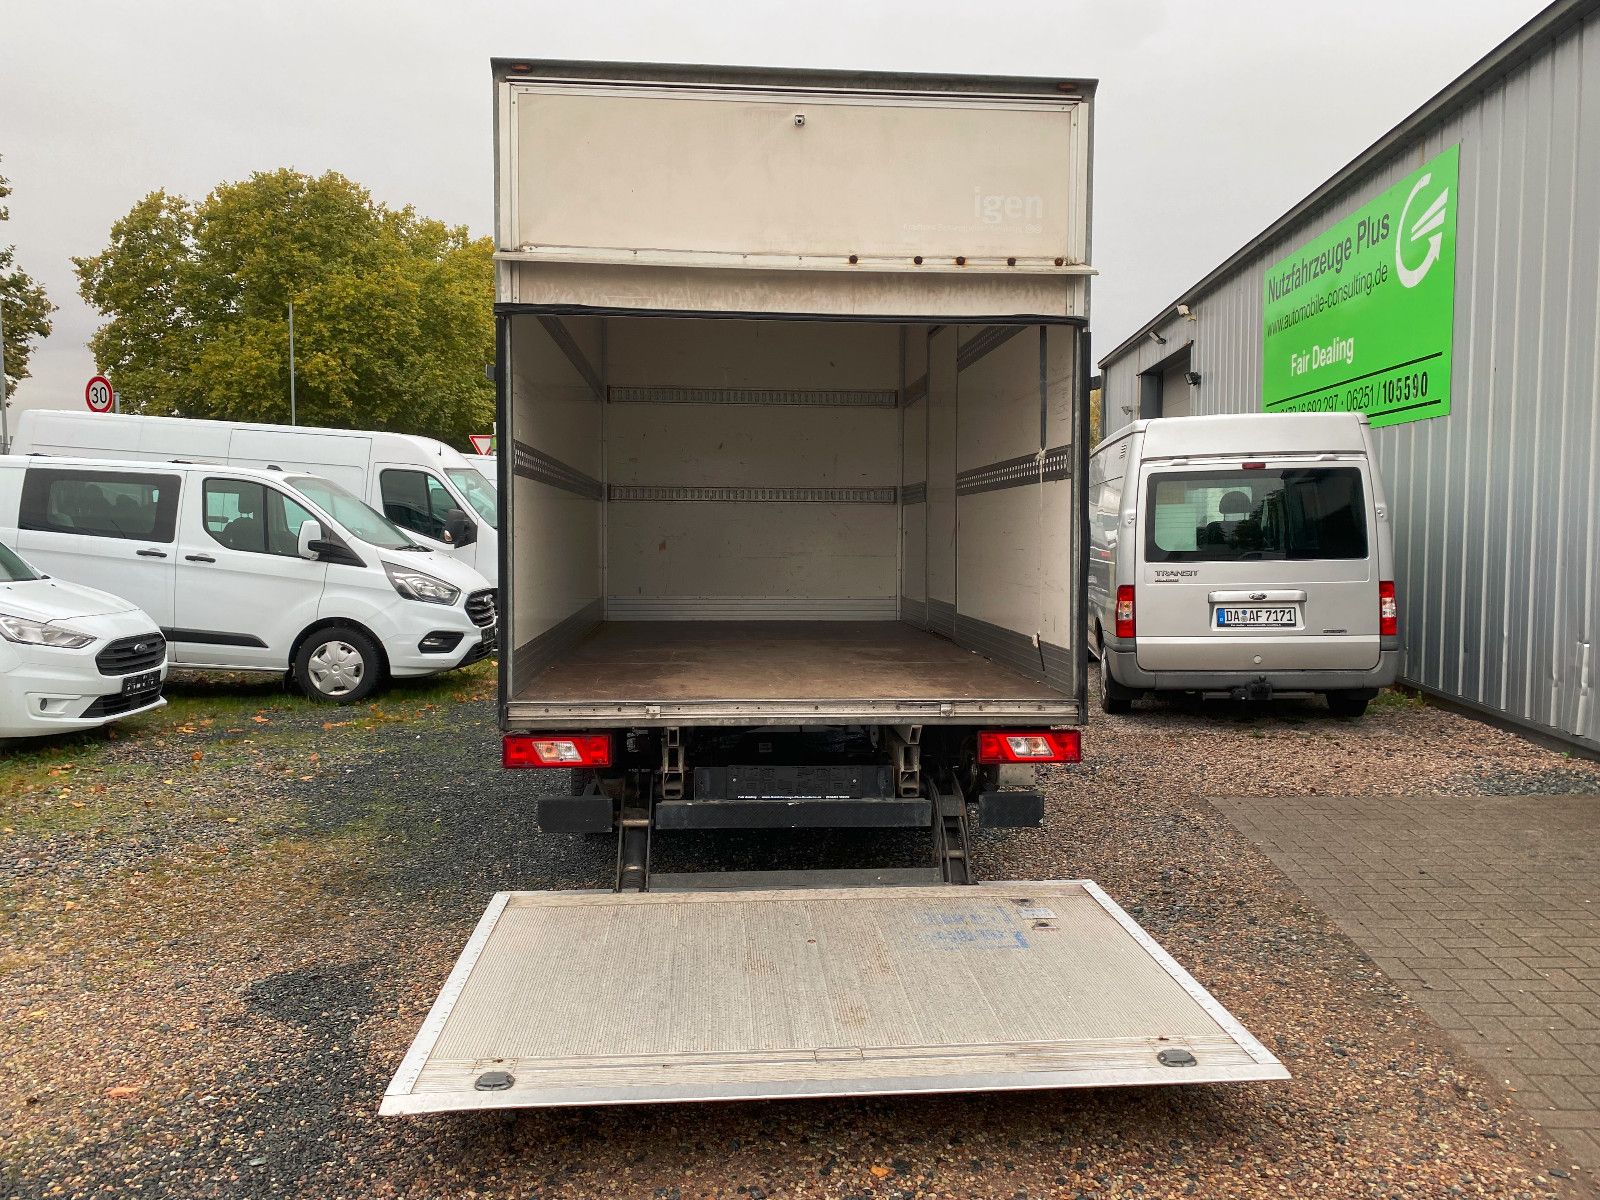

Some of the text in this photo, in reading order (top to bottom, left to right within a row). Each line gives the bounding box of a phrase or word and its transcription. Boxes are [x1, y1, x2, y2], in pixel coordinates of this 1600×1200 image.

[1268, 213, 1390, 304] Nutzfahrzeuge Plus
[1267, 261, 1388, 337] www.automobile-consulting.de
[1291, 337, 1354, 377] Fair Dealing
[91, 386, 107, 404] 30
[1382, 371, 1428, 404] 105590
[1226, 610, 1240, 622] DA
[1248, 610, 1263, 622] AF
[1265, 609, 1293, 622] 7171
